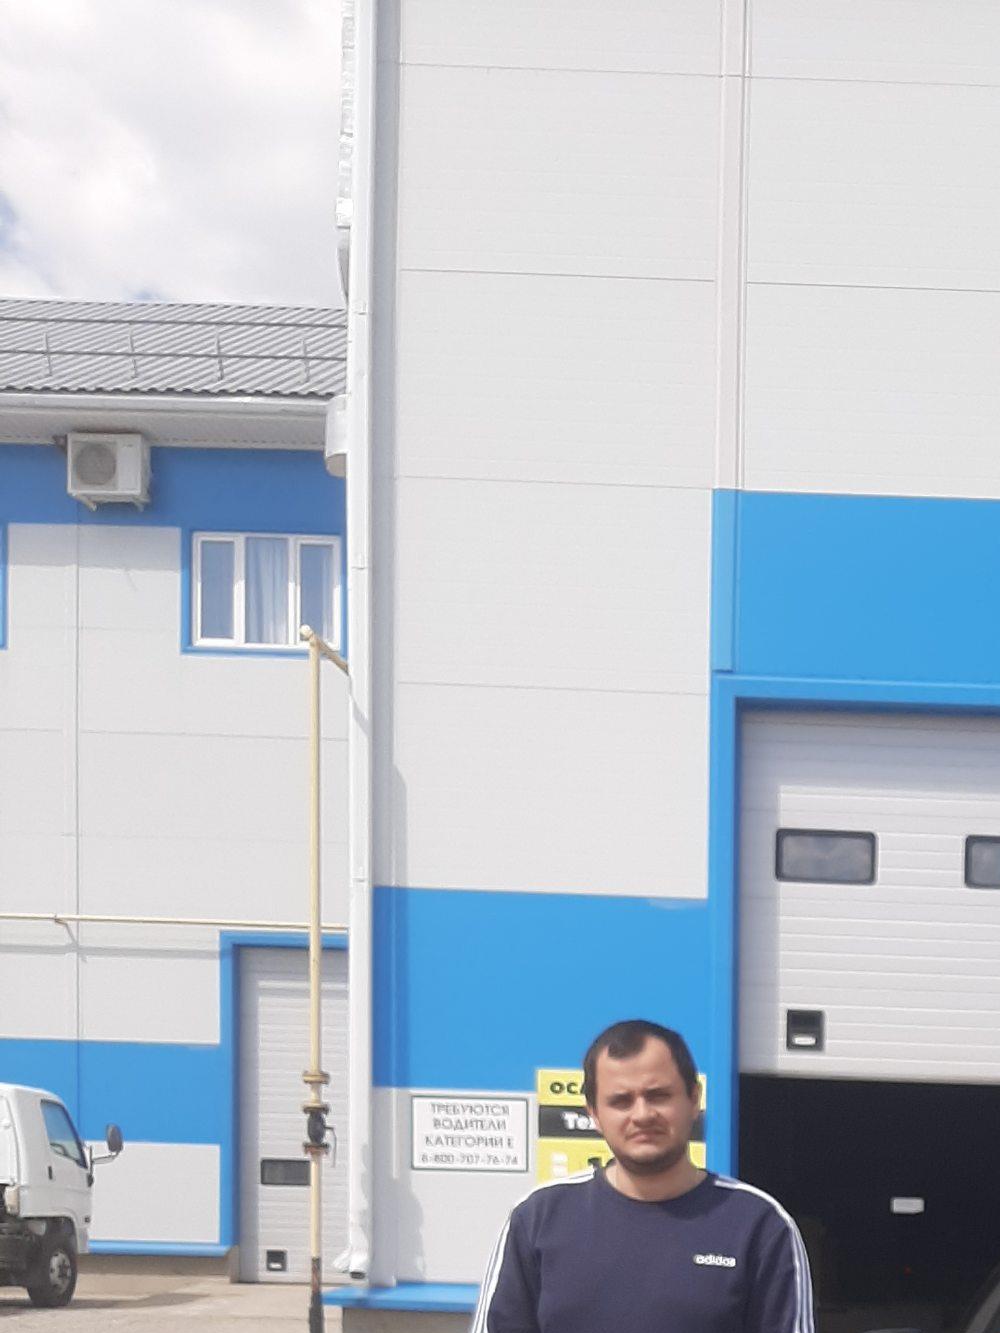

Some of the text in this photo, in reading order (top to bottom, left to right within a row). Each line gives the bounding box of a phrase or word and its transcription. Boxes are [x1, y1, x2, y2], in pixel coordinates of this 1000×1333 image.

[430, 1103, 510, 1116] ТРЕБУЮТСЯ
[432, 1118, 507, 1131] ВОДИТЕЛИ
[425, 1135, 504, 1148] КАТЕГОРИИ
[694, 1253, 737, 1268] adidas
